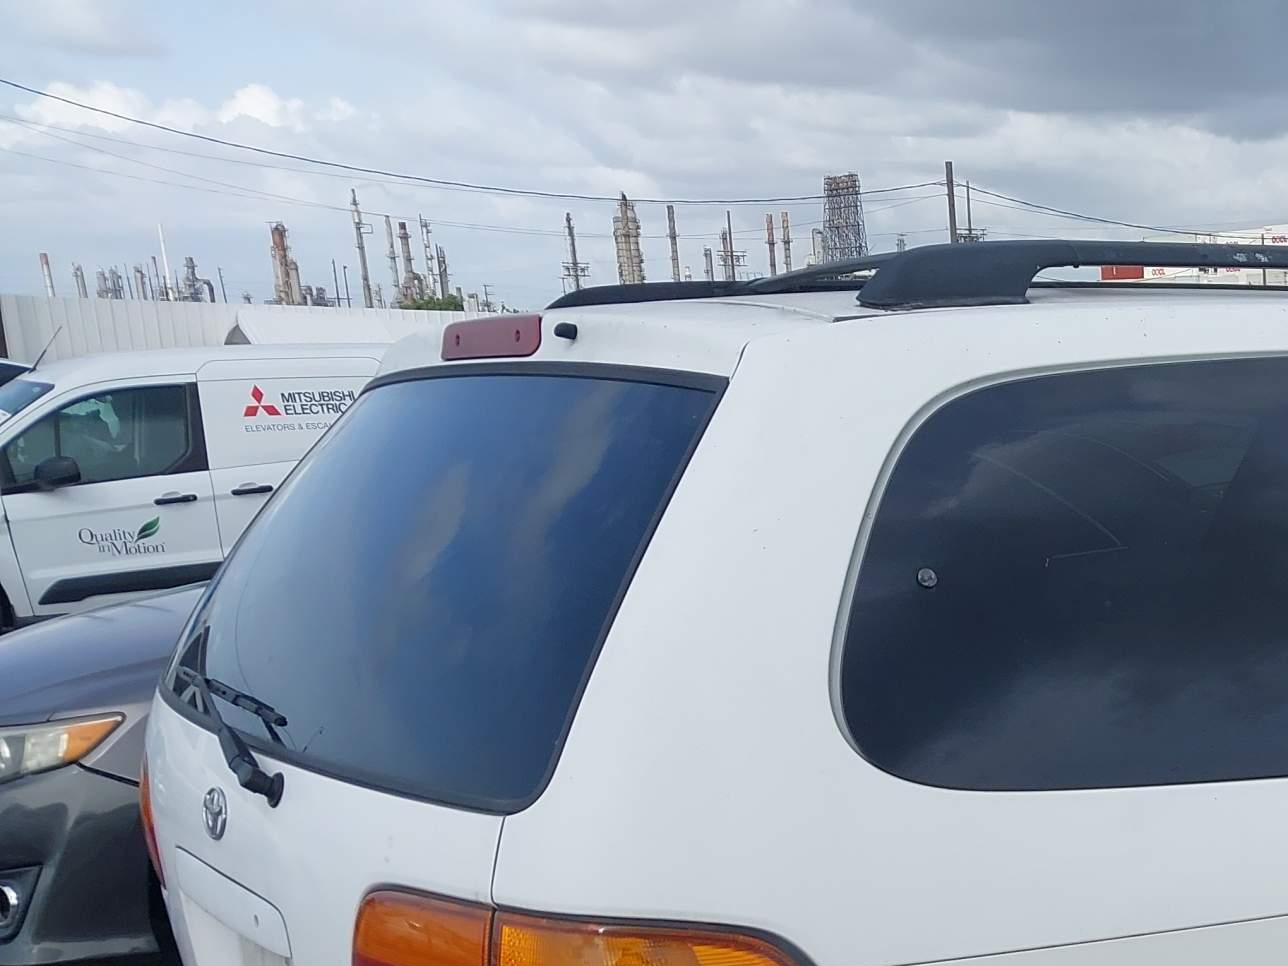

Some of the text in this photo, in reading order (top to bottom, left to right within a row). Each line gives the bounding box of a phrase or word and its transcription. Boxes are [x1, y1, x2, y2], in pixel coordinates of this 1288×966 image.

[280, 389, 357, 404] MITSUBISHI
[283, 402, 349, 416] ELECTRIC
[244, 423, 295, 433] ELEVATORS
[299, 422, 305, 431] &
[78, 528, 135, 545] Quality
[96, 541, 111, 553] in
